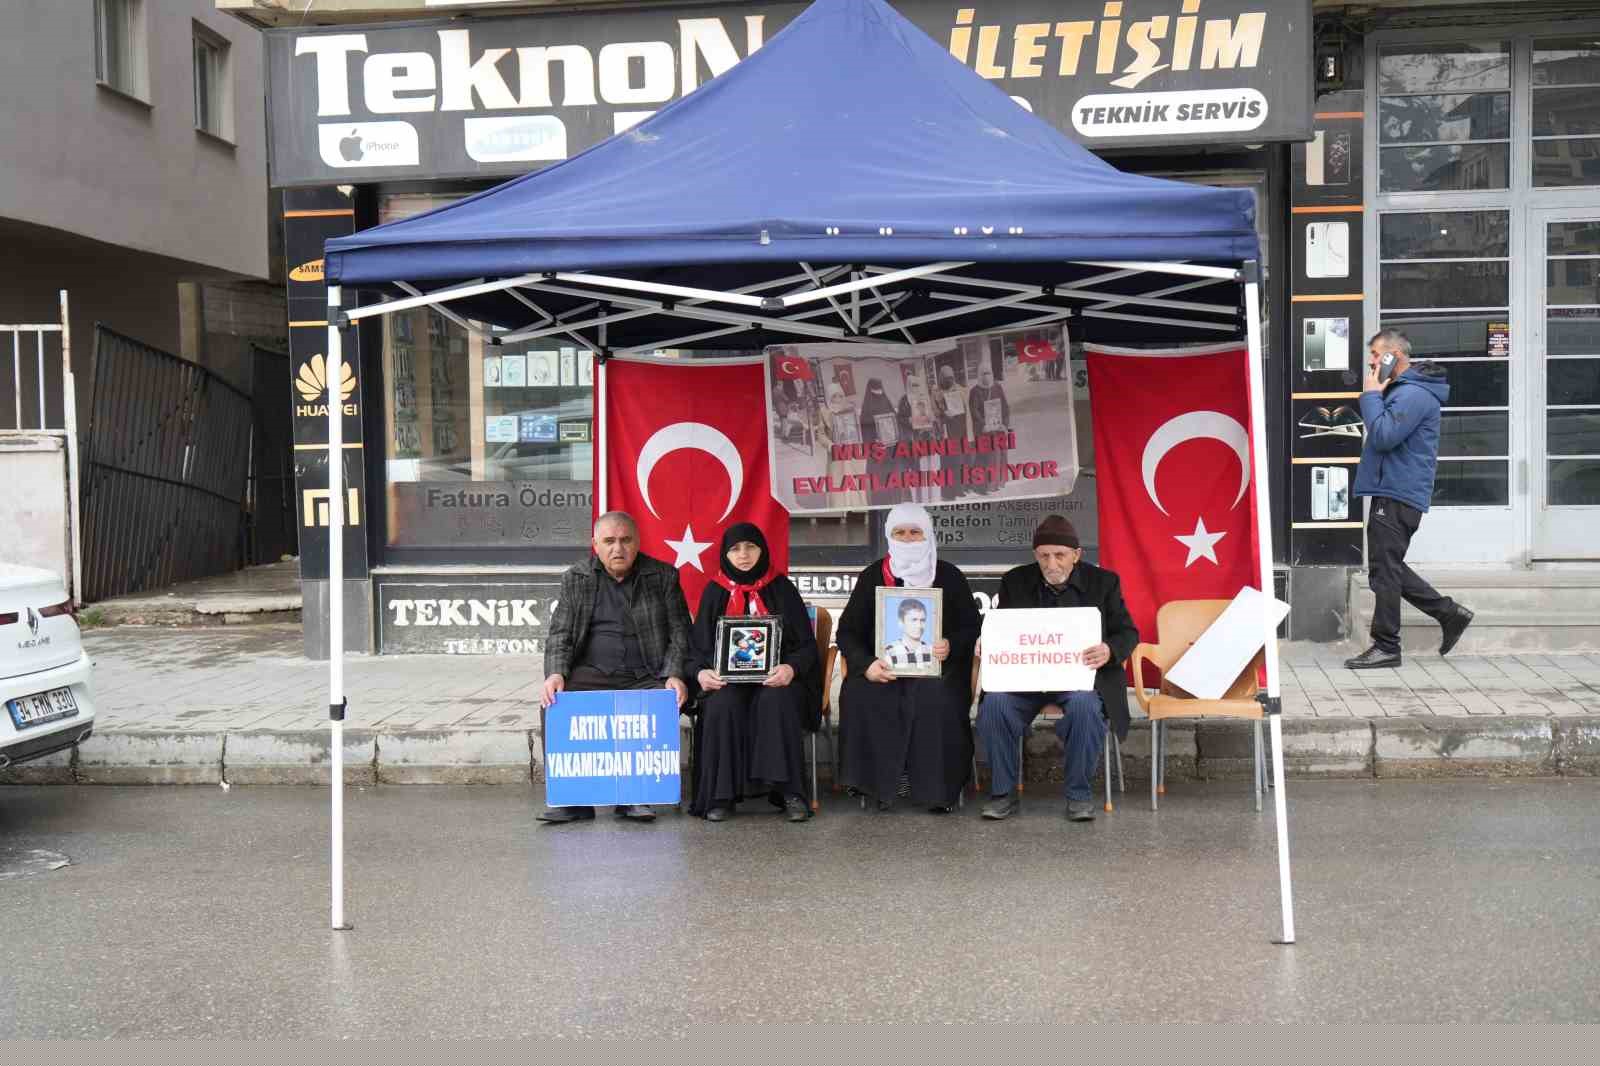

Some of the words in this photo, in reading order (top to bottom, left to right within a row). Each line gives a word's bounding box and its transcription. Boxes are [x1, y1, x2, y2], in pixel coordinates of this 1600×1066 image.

[949, 0, 1268, 90] İLETİŞİM
[1079, 100, 1169, 125] TEKNİK
[1176, 96, 1261, 121] SERVİS
[296, 403, 358, 417] HUAEI
[831, 442, 887, 464] MUŞ
[894, 432, 1017, 457] ANNELERİ
[793, 468, 955, 496] EVLATLARINI
[960, 460, 1059, 486] İSTİYOR
[426, 488, 510, 508] Fatura
[932, 514, 992, 527] Telefon
[444, 638, 539, 655] TELEFON
[1019, 633, 1064, 646] EVLAT
[15, 700, 31, 721] 34
[569, 715, 608, 741] ARTIK
[610, 714, 649, 740] YETER
[547, 751, 632, 778] YAKAMIZDAN
[635, 744, 680, 783] DÜŞÜN
